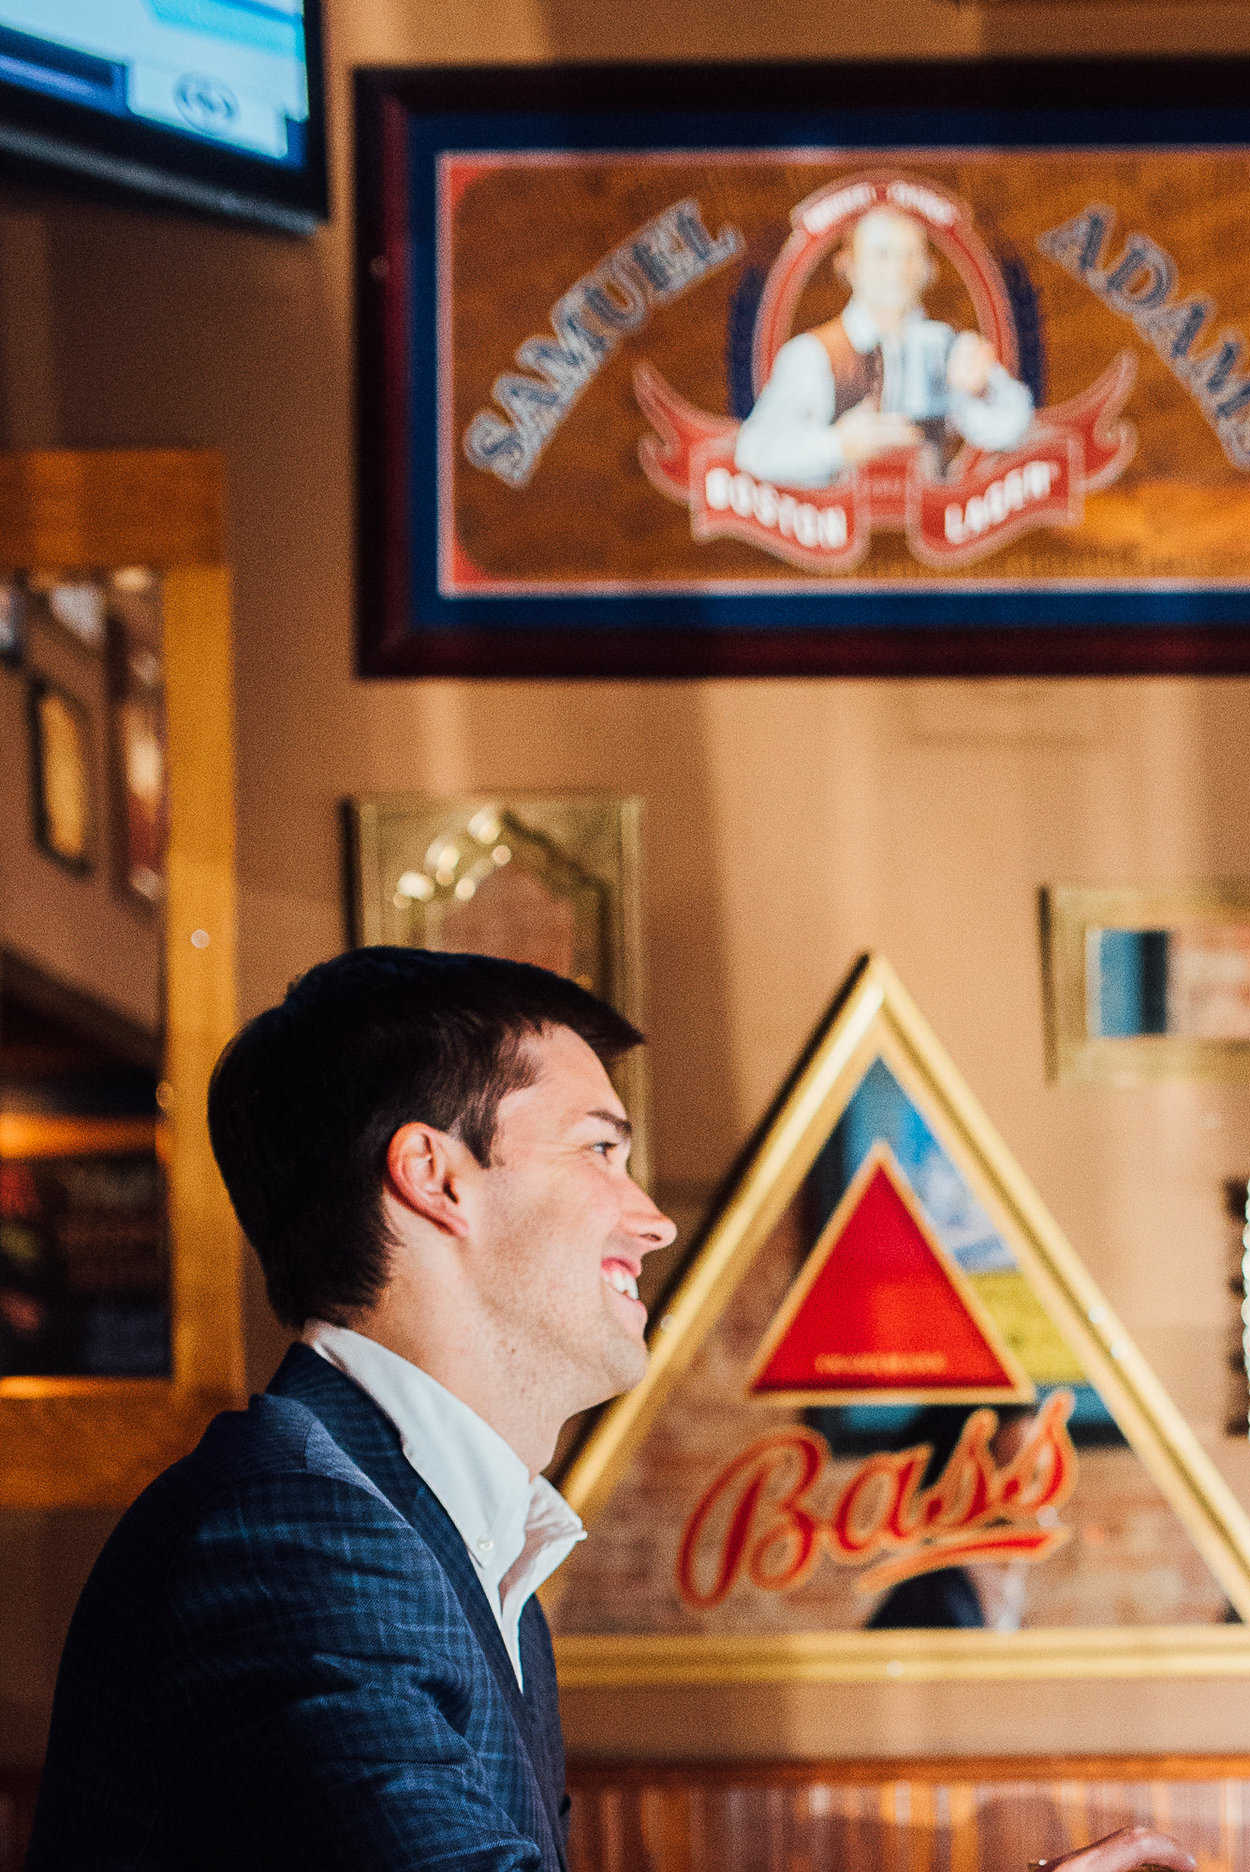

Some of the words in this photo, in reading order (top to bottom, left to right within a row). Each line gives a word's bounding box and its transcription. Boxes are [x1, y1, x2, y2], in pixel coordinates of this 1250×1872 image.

[466, 200, 742, 487] SAMUEL
[705, 467, 848, 549] BOSTON
[944, 459, 1061, 546] LAGER
[675, 1388, 1078, 1611] Bass
